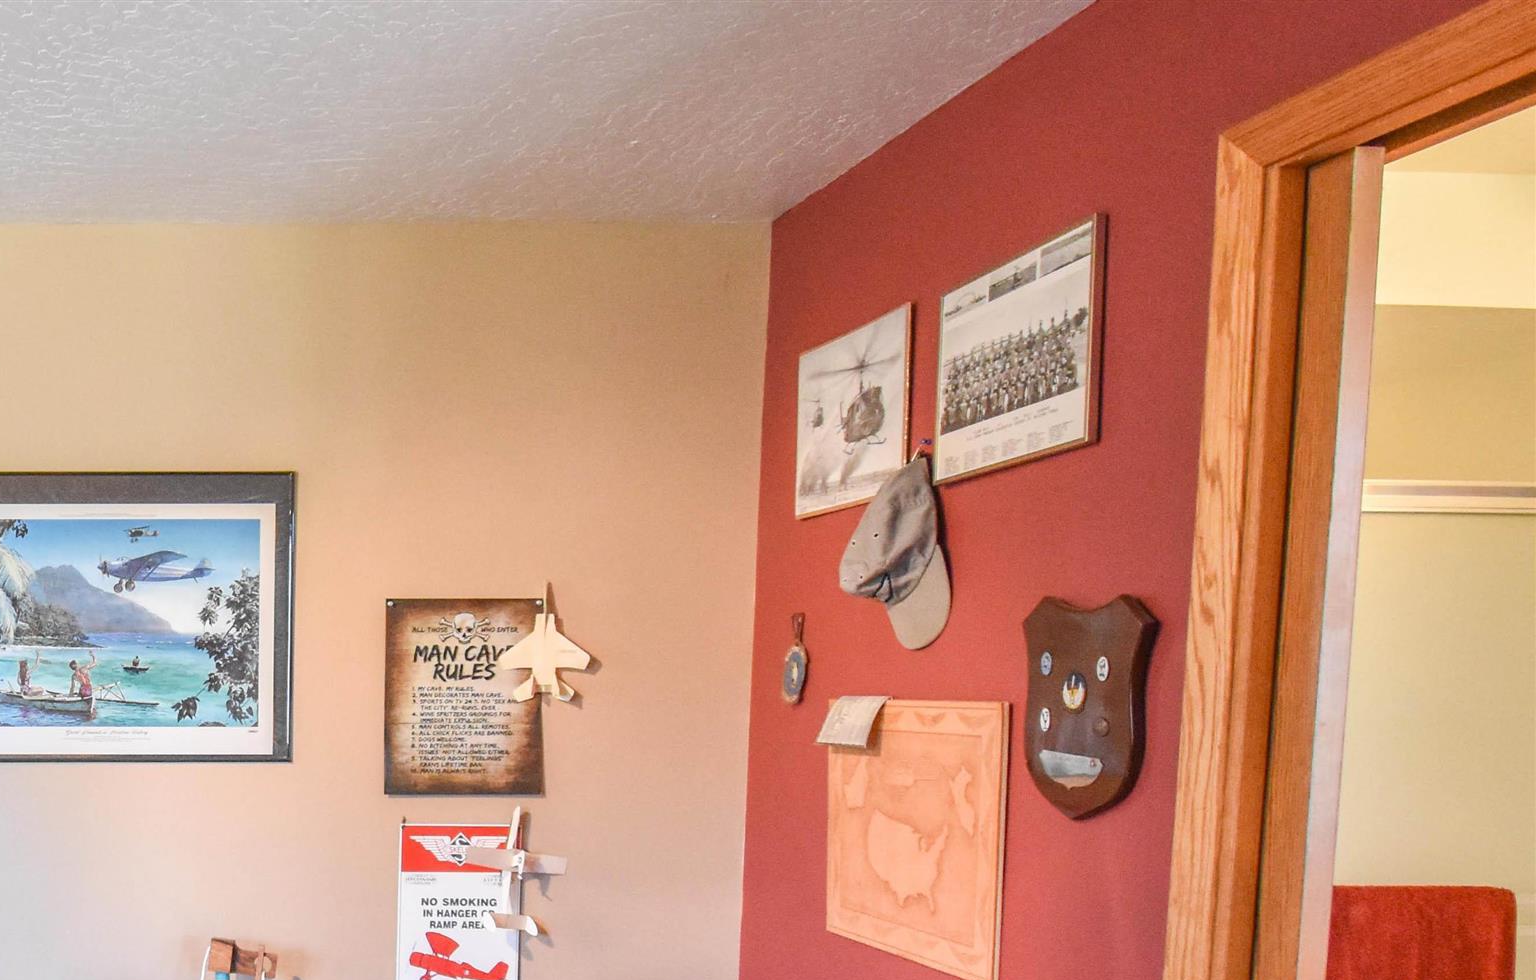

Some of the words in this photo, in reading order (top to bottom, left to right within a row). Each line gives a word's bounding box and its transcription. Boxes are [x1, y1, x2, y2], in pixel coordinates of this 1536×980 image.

[413, 645, 458, 663] MAN
[465, 645, 514, 663] CAV
[433, 663, 497, 682] RULES
[421, 897, 438, 906] NO
[442, 898, 498, 907] SMOKING
[423, 909, 433, 917] IN
[437, 909, 478, 918] HANGER
[429, 920, 458, 929] RAMP
